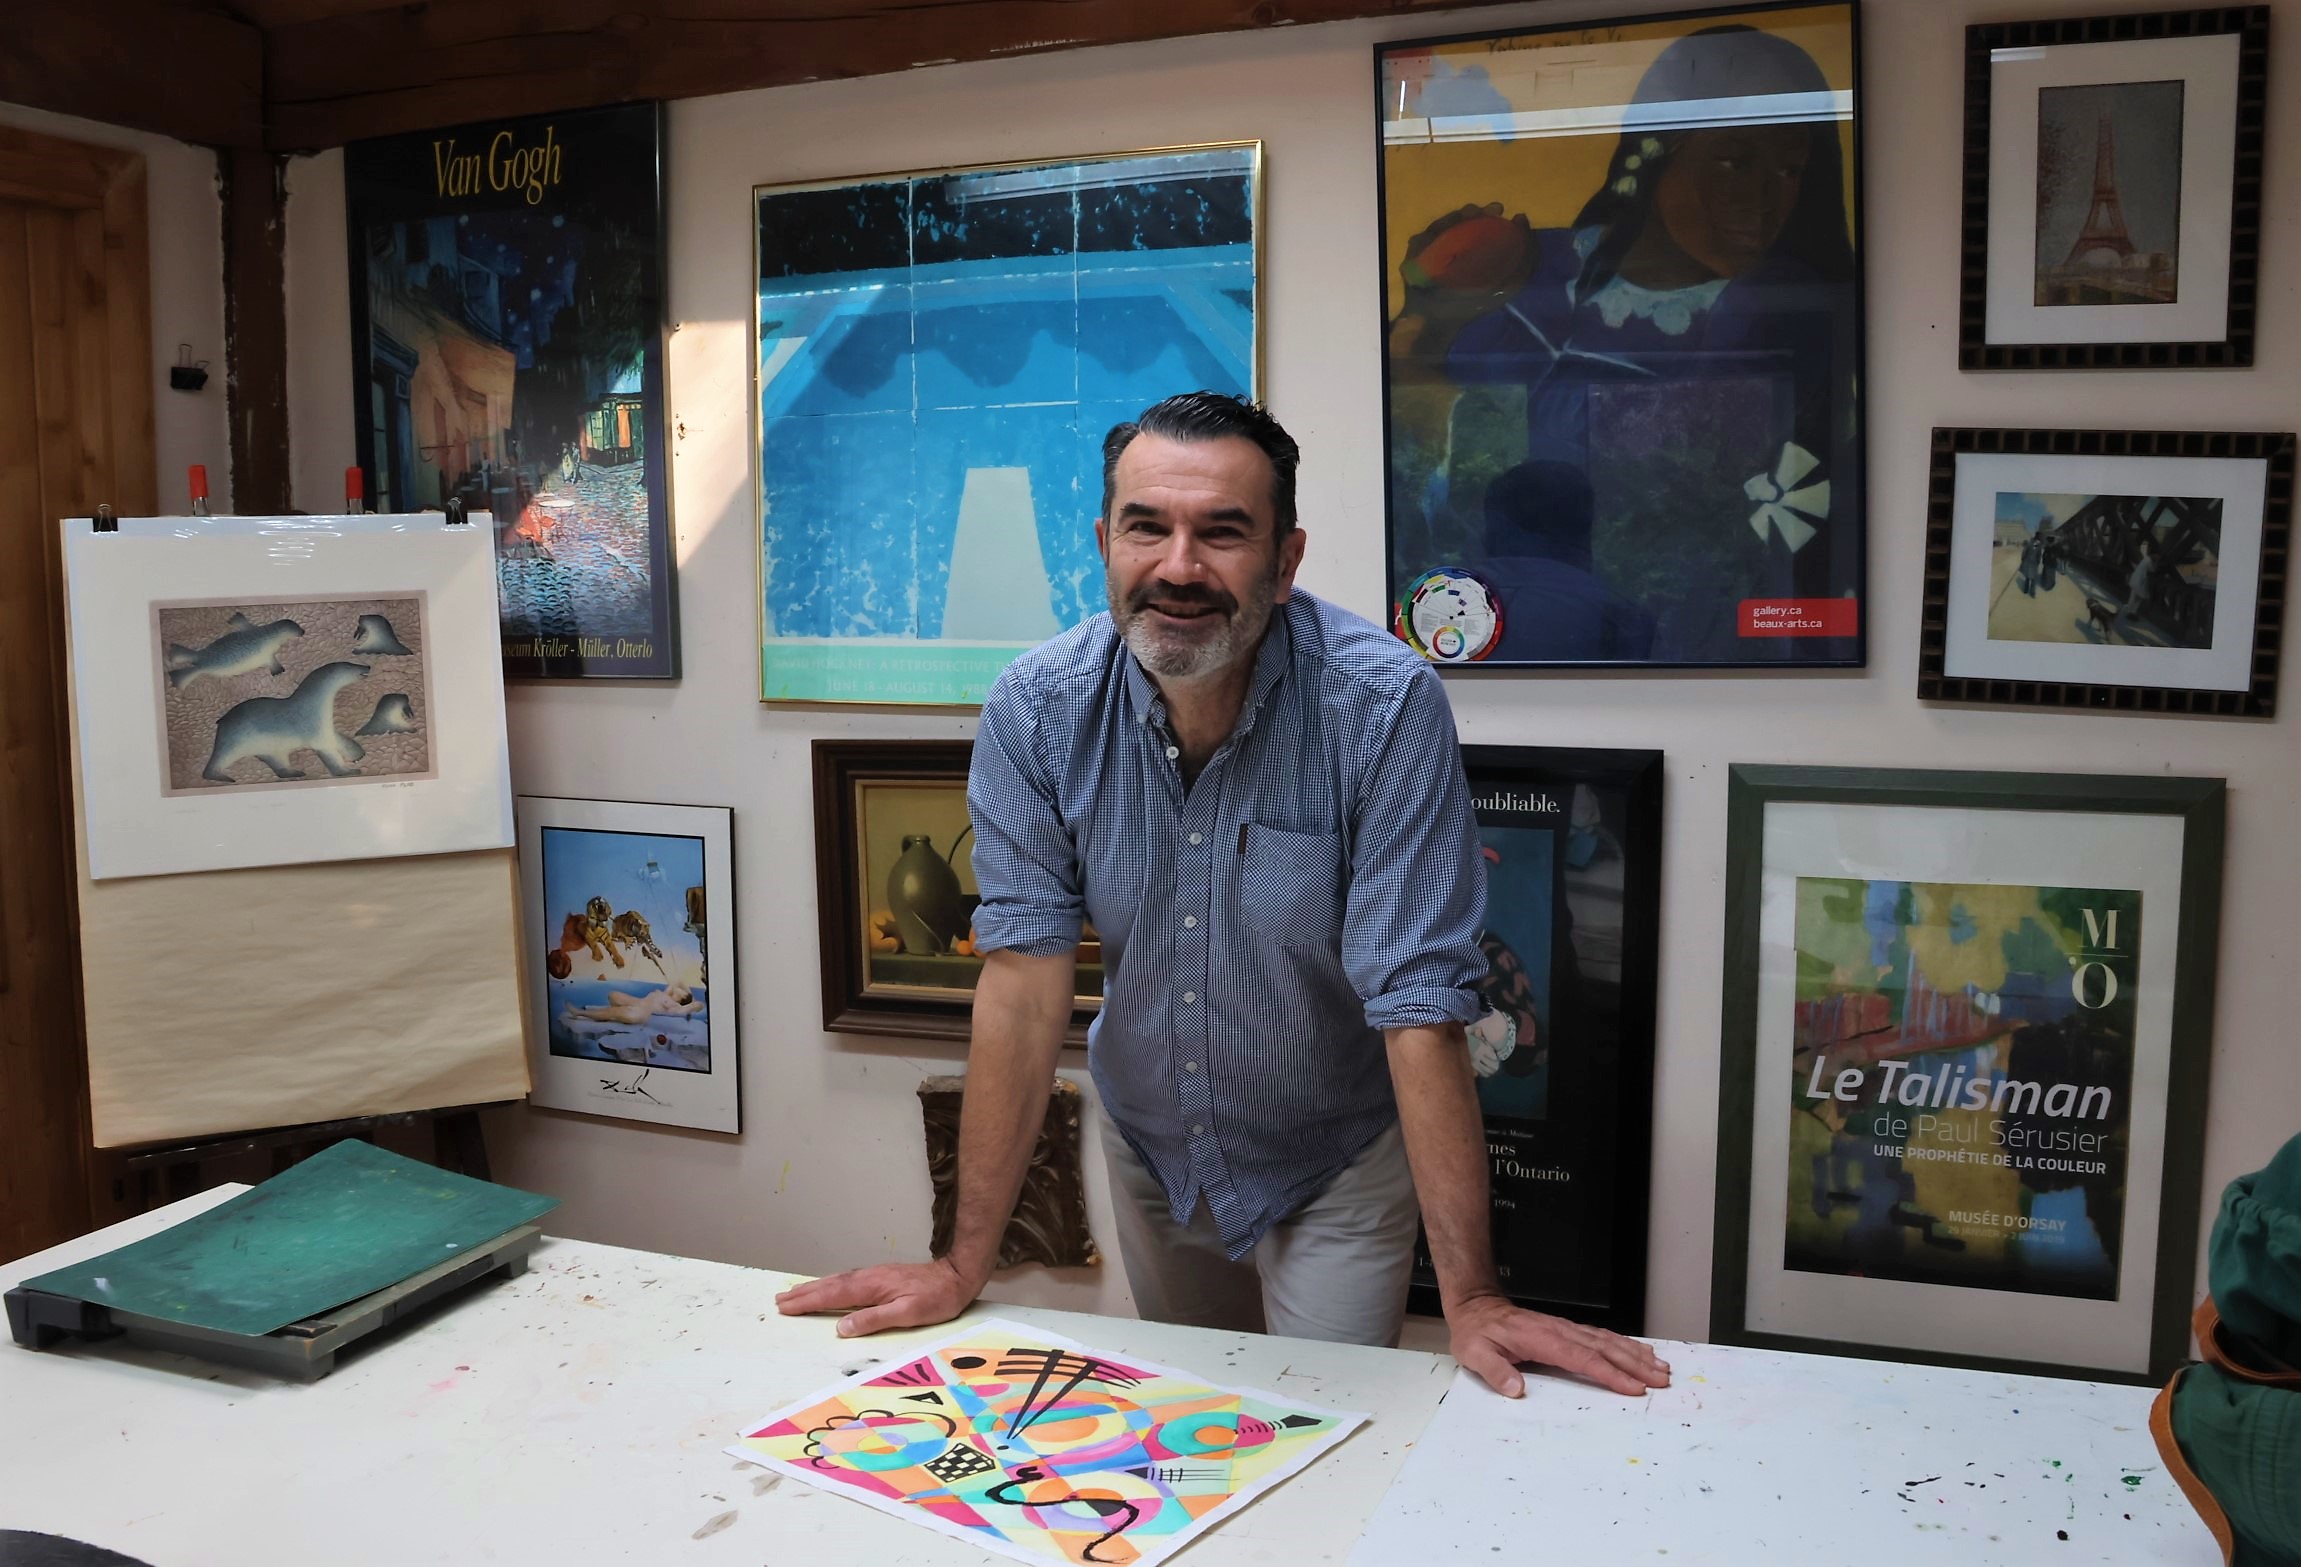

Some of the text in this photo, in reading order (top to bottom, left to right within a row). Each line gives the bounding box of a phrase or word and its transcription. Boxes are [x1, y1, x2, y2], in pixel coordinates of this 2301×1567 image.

[432, 125, 562, 206] Van Gogh
[1753, 605, 1803, 618] gallery.ca
[1753, 618, 1823, 629] beaux-arts.ca
[533, 637, 568, 658] Kröller
[616, 637, 653, 658] Otterlo
[886, 680, 937, 695] AUGUST
[2079, 907, 2122, 950] M
[1806, 1055, 2113, 1121] Le Talisman
[1873, 1110, 2109, 1154] de Paul Sérusier
[1495, 1159, 1570, 1182] l'Ontario
[1873, 1144, 2107, 1175] UNE PROPHÉTIE DE LA COULEUR
[1948, 1209, 2068, 1233] MUSÉE D'ORSAY
